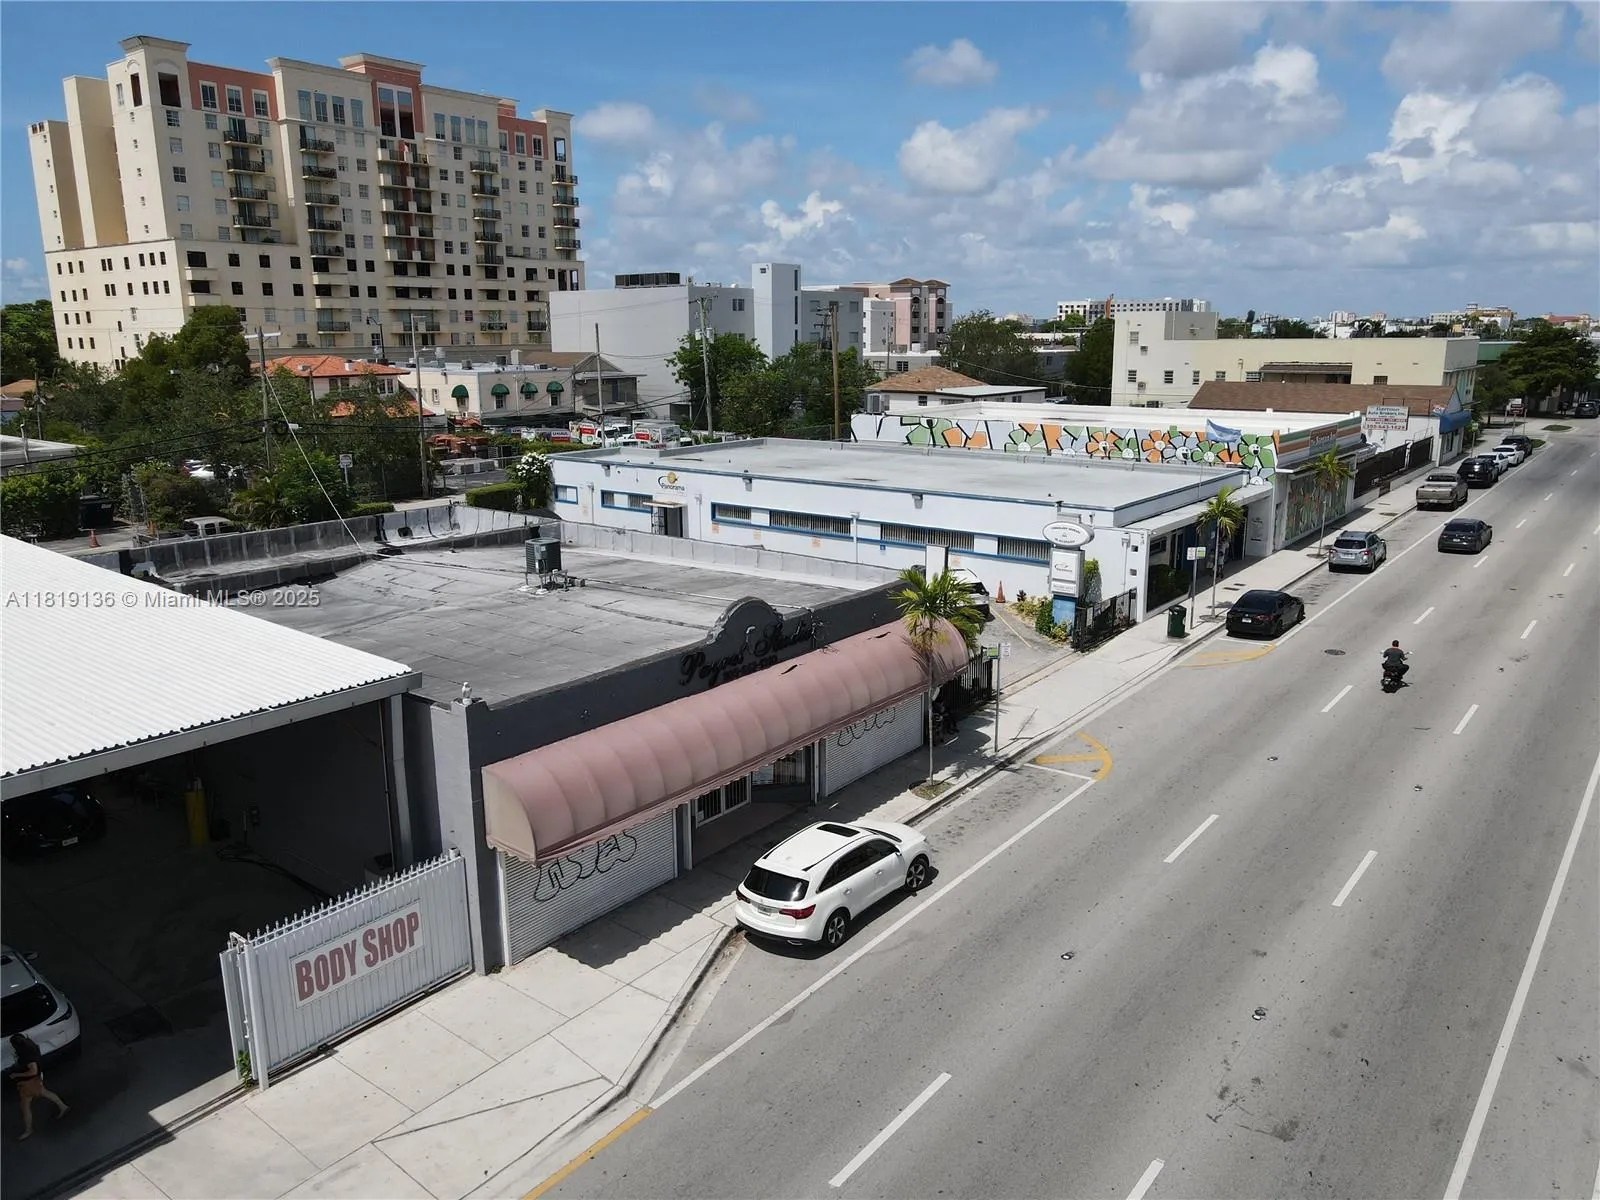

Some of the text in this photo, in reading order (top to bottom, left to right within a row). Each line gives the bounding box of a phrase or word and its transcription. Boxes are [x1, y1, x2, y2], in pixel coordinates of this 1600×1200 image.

[661, 482, 685, 491] Panorama
[295, 911, 419, 1001] BODY SHOP
